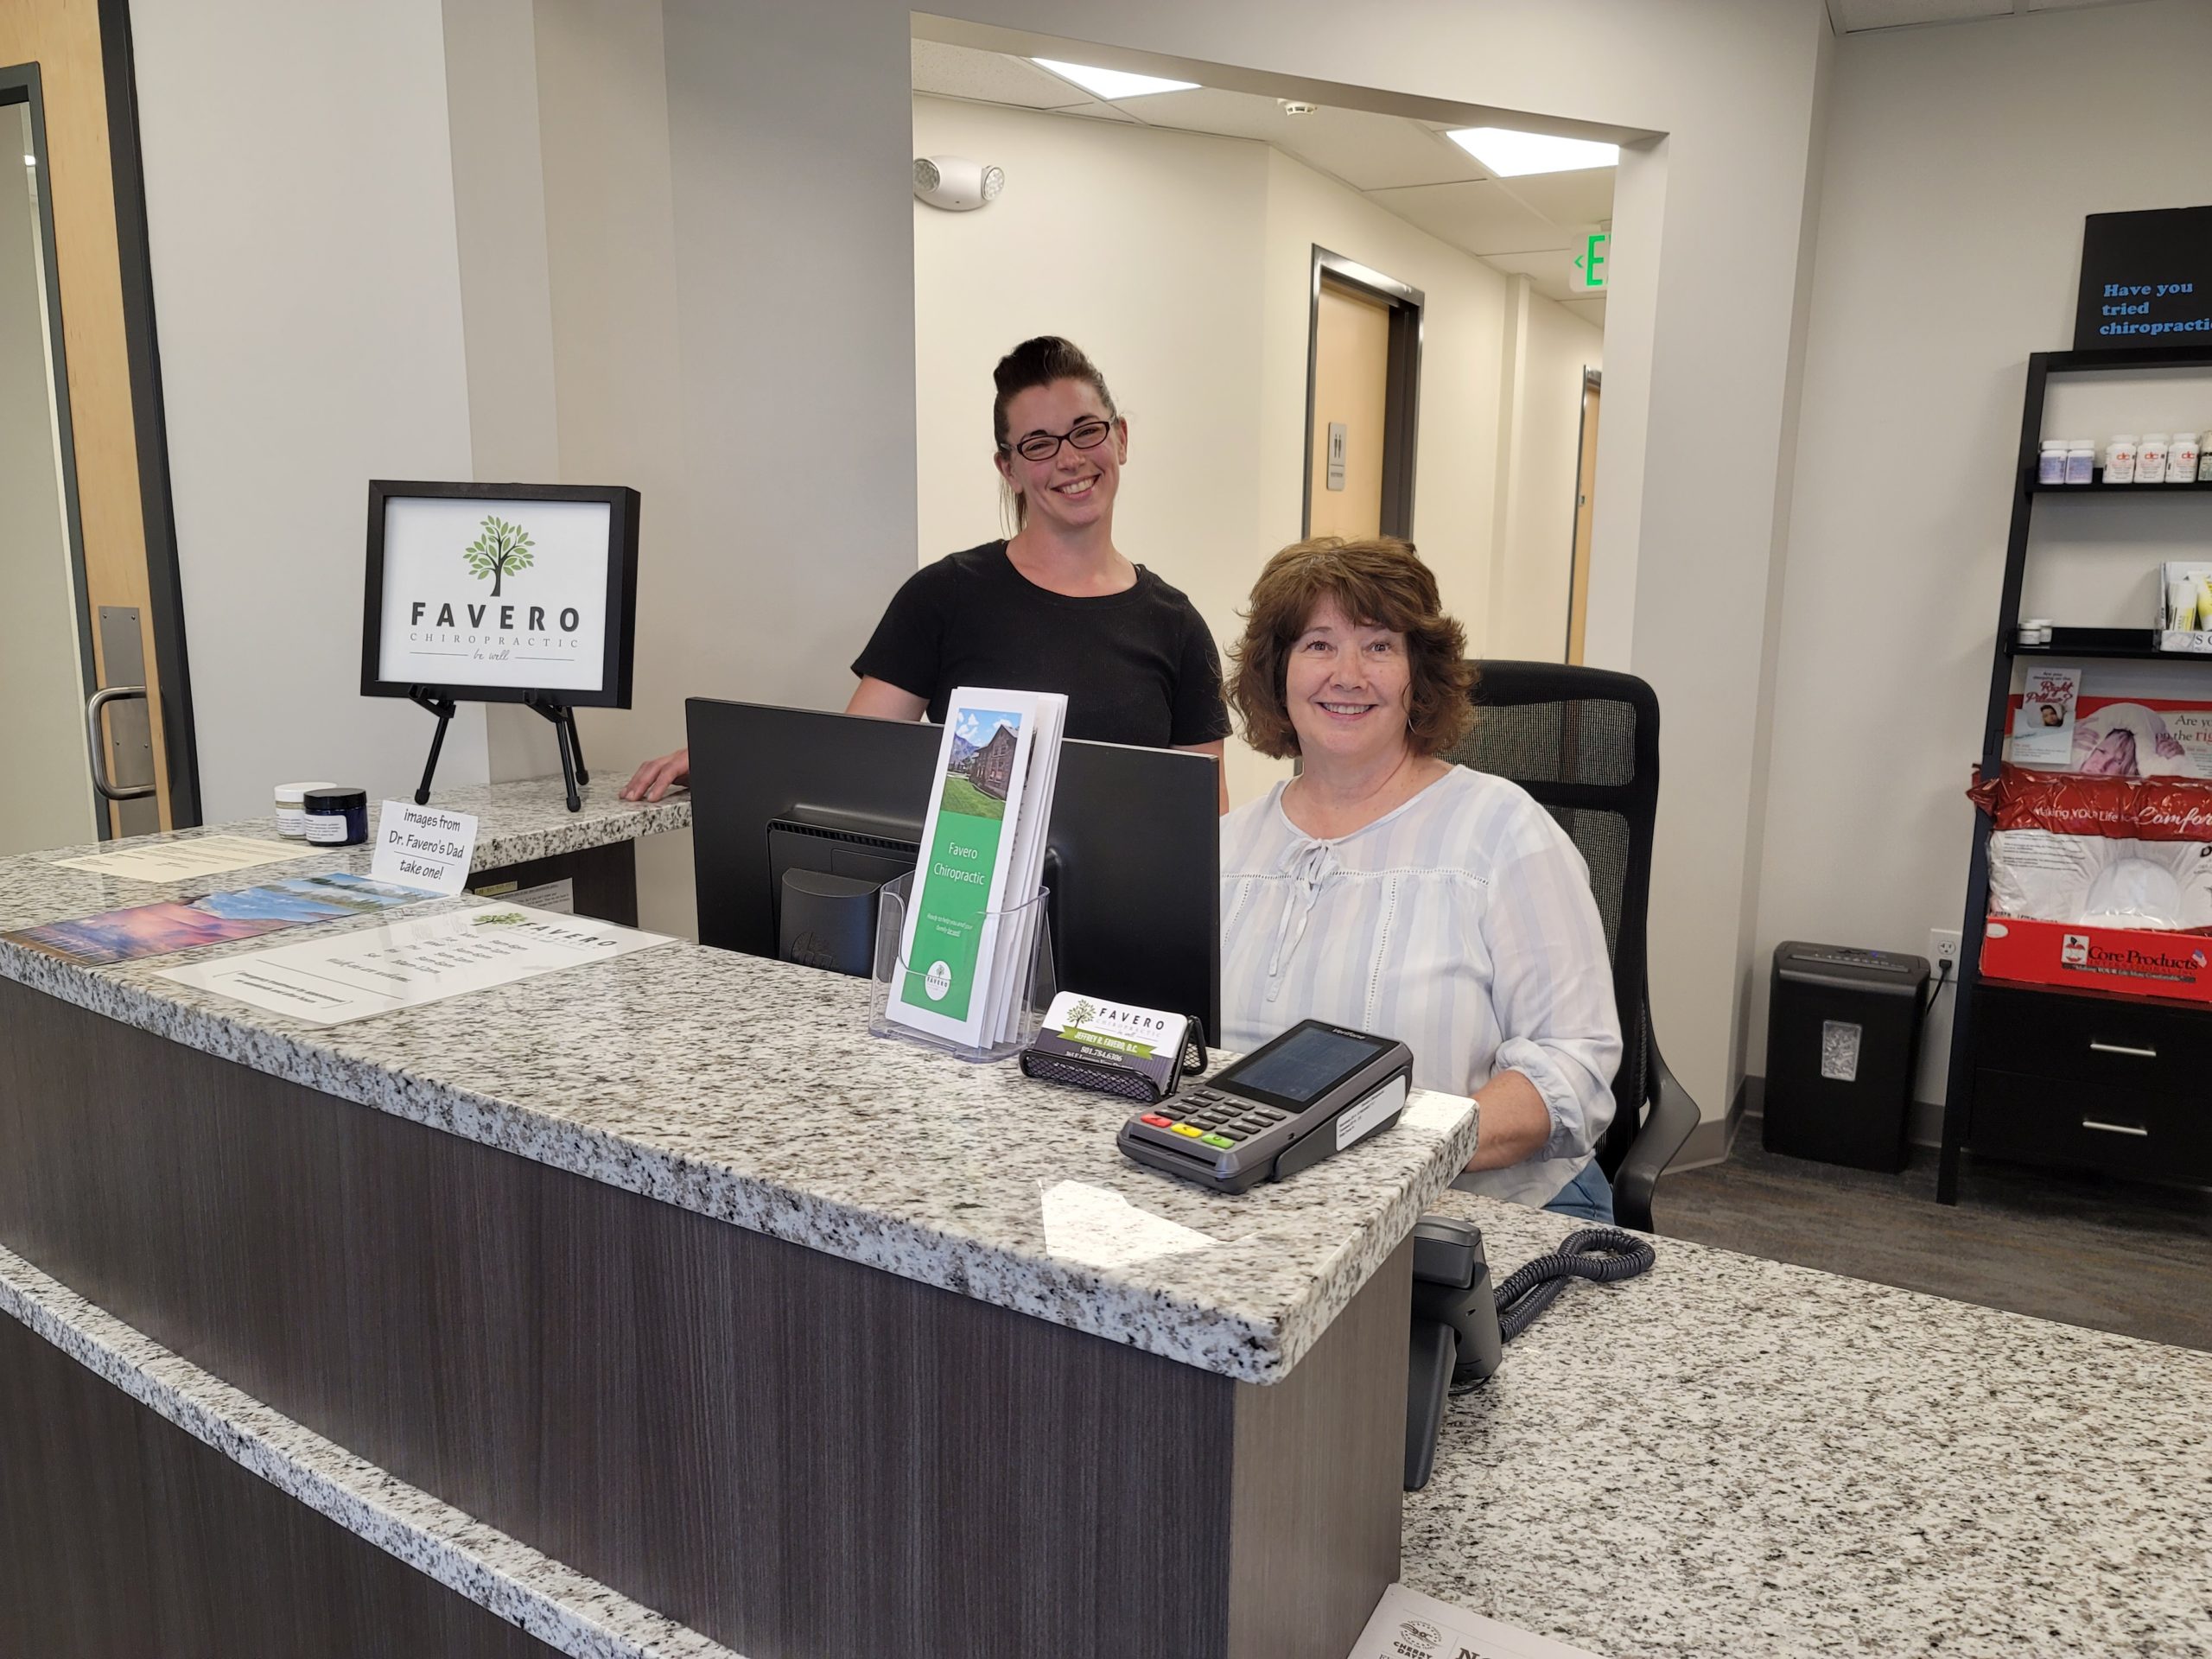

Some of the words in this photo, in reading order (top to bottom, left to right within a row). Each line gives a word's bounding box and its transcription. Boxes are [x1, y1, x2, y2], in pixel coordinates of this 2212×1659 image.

[2104, 283, 2152, 297] Have
[2157, 283, 2193, 297] you
[2102, 302, 2149, 316] tried
[2100, 318, 2212, 335] chiropracti
[410, 601, 580, 632] FAVERO
[410, 632, 578, 648] CHIROPRACTIC
[473, 648, 484, 660] be
[488, 649, 511, 661] well
[2040, 681, 2073, 696] Right
[2175, 715, 2197, 727] Are
[2174, 729, 2192, 741] the
[404, 808, 438, 829] images
[439, 815, 461, 832] from
[2099, 810, 2117, 822] Life
[389, 830, 404, 846] Dr.
[406, 834, 445, 855] Favero's
[446, 842, 465, 859] Dad
[949, 842, 977, 859] Favero
[399, 859, 422, 875] take
[422, 867, 444, 880] one!
[934, 862, 985, 885] Chiropractic
[517, 922, 617, 945] FAVERO
[2088, 945, 2124, 962] Core
[2126, 950, 2198, 969] Products
[926, 976, 948, 988] FAVERO
[1099, 1007, 1165, 1031] FAVERO
[1074, 1031, 1096, 1044] JEFFREY
[1104, 1038, 1126, 1051] FAVERO,
[1393, 1641, 1433, 1659] CHERRY
